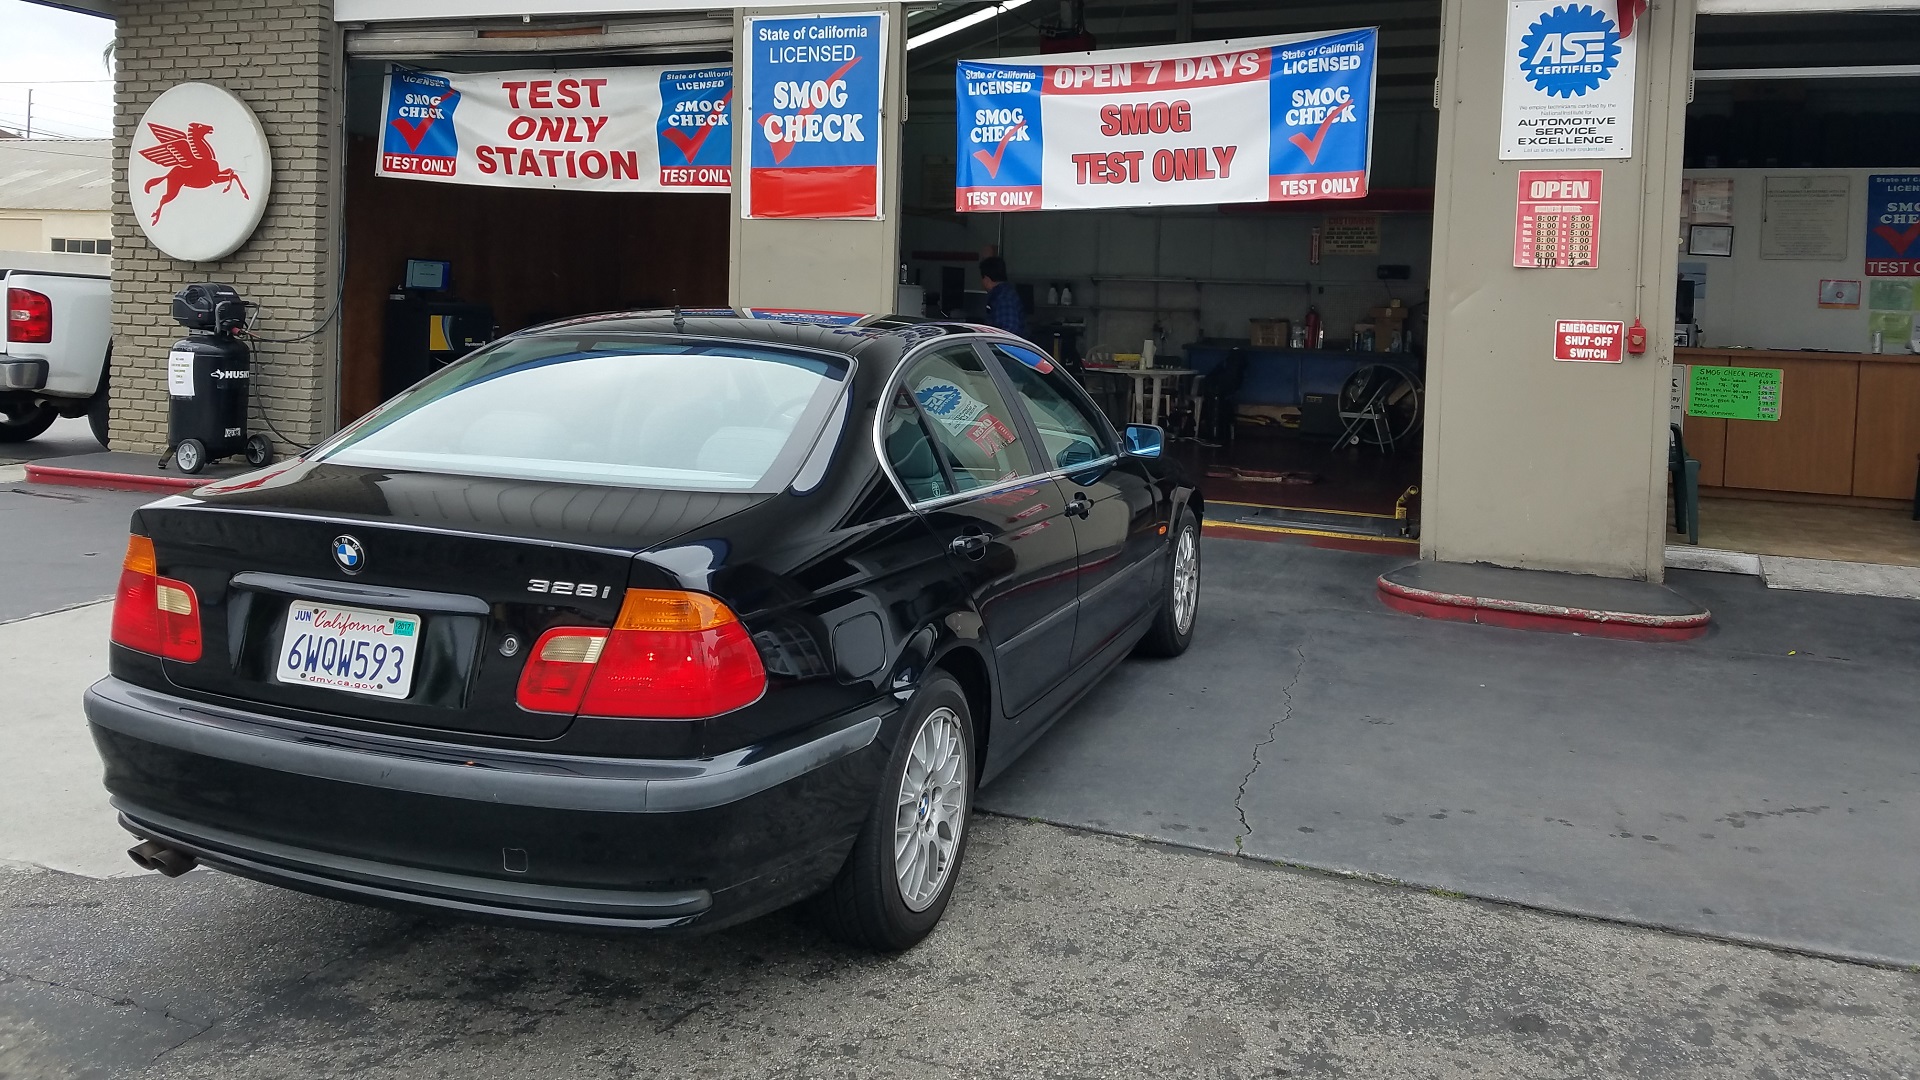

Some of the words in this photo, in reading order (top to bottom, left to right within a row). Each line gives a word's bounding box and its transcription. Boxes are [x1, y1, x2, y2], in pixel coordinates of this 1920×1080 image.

[759, 28, 790, 41] State
[794, 26, 806, 40] of
[809, 25, 868, 39] California
[770, 44, 856, 64] LICENSED
[1282, 50, 1306, 60] State
[1308, 47, 1318, 57] of
[1319, 41, 1364, 54] California
[1530, 31, 1606, 65] ASE
[1053, 64, 1132, 88] OPEN
[1143, 62, 1164, 84] 7
[1174, 52, 1260, 82] DAYS
[1284, 56, 1361, 75] LICENSED
[1535, 64, 1602, 75] CERTIFIED
[966, 70, 986, 80] State
[986, 70, 996, 79] of
[996, 70, 1036, 80] California
[676, 80, 724, 90] LICENSED
[968, 80, 1032, 96] LICENSED
[404, 94, 442, 106] SMOG
[501, 78, 608, 110] TEST
[773, 80, 848, 110] SMOG
[1292, 86, 1351, 108] SMOG
[398, 106, 444, 120] CHECK
[674, 100, 726, 113] SMOG
[668, 114, 729, 126] CHECK
[975, 108, 1024, 126] SMOG
[1100, 100, 1192, 137] SMOG
[1285, 104, 1357, 127] CHECK
[1518, 116, 1616, 127] AUTOMOTIVE
[506, 116, 609, 143] ONLY
[763, 114, 865, 143] CHECK
[970, 126, 1030, 143] CHECK
[1535, 126, 1597, 136] SERVICE
[1518, 136, 1614, 146] EXCELLENCE
[384, 156, 419, 172] TEST
[420, 158, 454, 174] ONLY
[475, 145, 639, 180] STATION
[1072, 150, 1144, 185] TEST
[1152, 146, 1238, 182] ONLY
[662, 169, 696, 183] TEST
[1280, 180, 1318, 196] TEST
[1321, 177, 1359, 194] ONLY
[1530, 180, 1590, 199] OPEN
[966, 192, 997, 206] TEST
[1000, 192, 1033, 206] ONLY
[1868, 262, 1910, 274] TEST
[1560, 323, 1620, 334] EMERGENCY
[1565, 336, 1612, 346] SHUT-OFF
[1570, 348, 1607, 358] SWITCH
[1700, 368, 1721, 376] SMOG
[334, 538, 360, 550] BMW
[527, 578, 611, 599] 328i
[294, 610, 312, 622] JUN
[314, 610, 394, 636] California
[398, 622, 411, 630] 2017
[288, 634, 404, 684] 6WQW593
[310, 675, 376, 690] dmv.ca.gov
